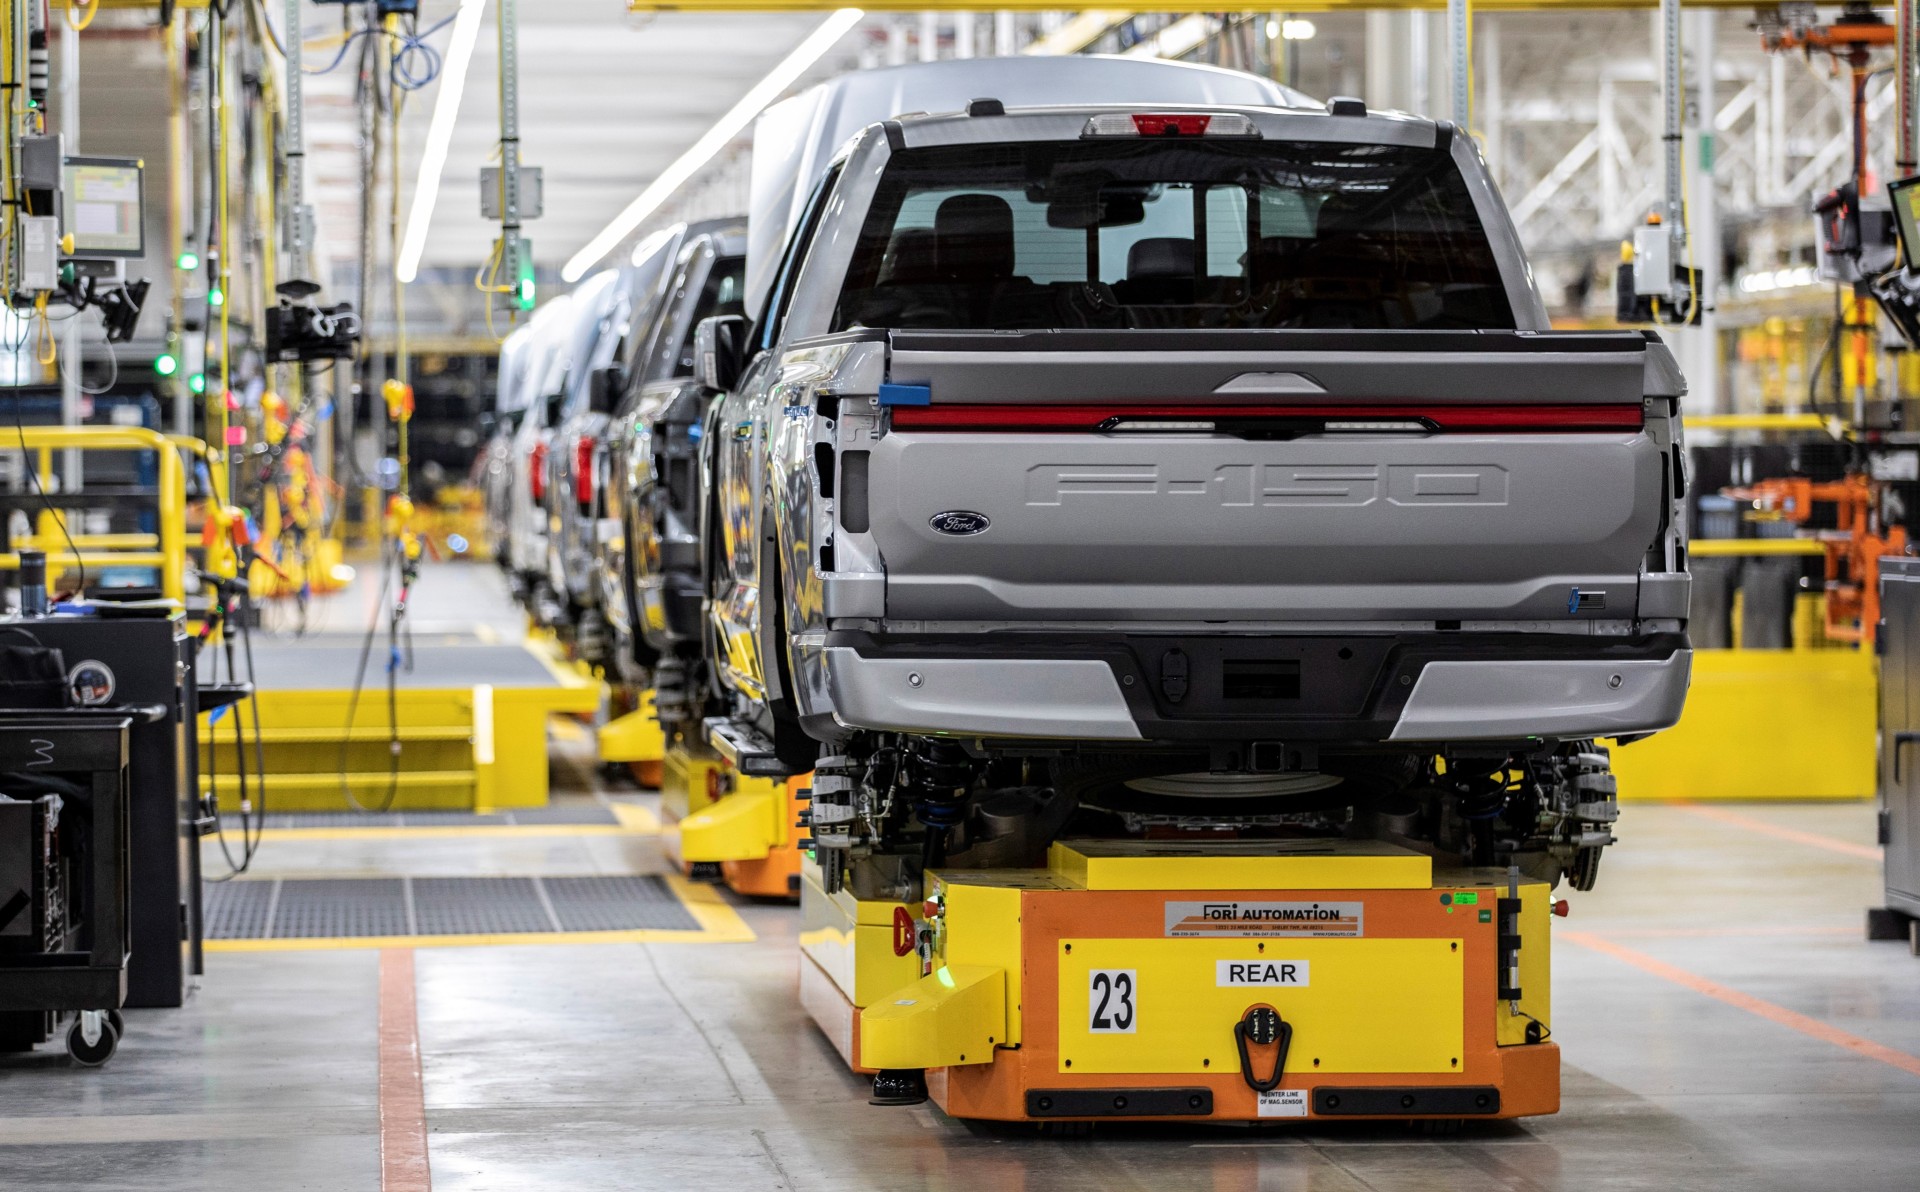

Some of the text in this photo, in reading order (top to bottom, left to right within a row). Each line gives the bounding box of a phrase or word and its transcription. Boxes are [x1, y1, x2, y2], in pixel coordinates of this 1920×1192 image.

[1025, 463, 1509, 506] F-150
[944, 516, 976, 530] Ford
[1229, 964, 1297, 983] REAR
[1092, 972, 1133, 1030] 23
